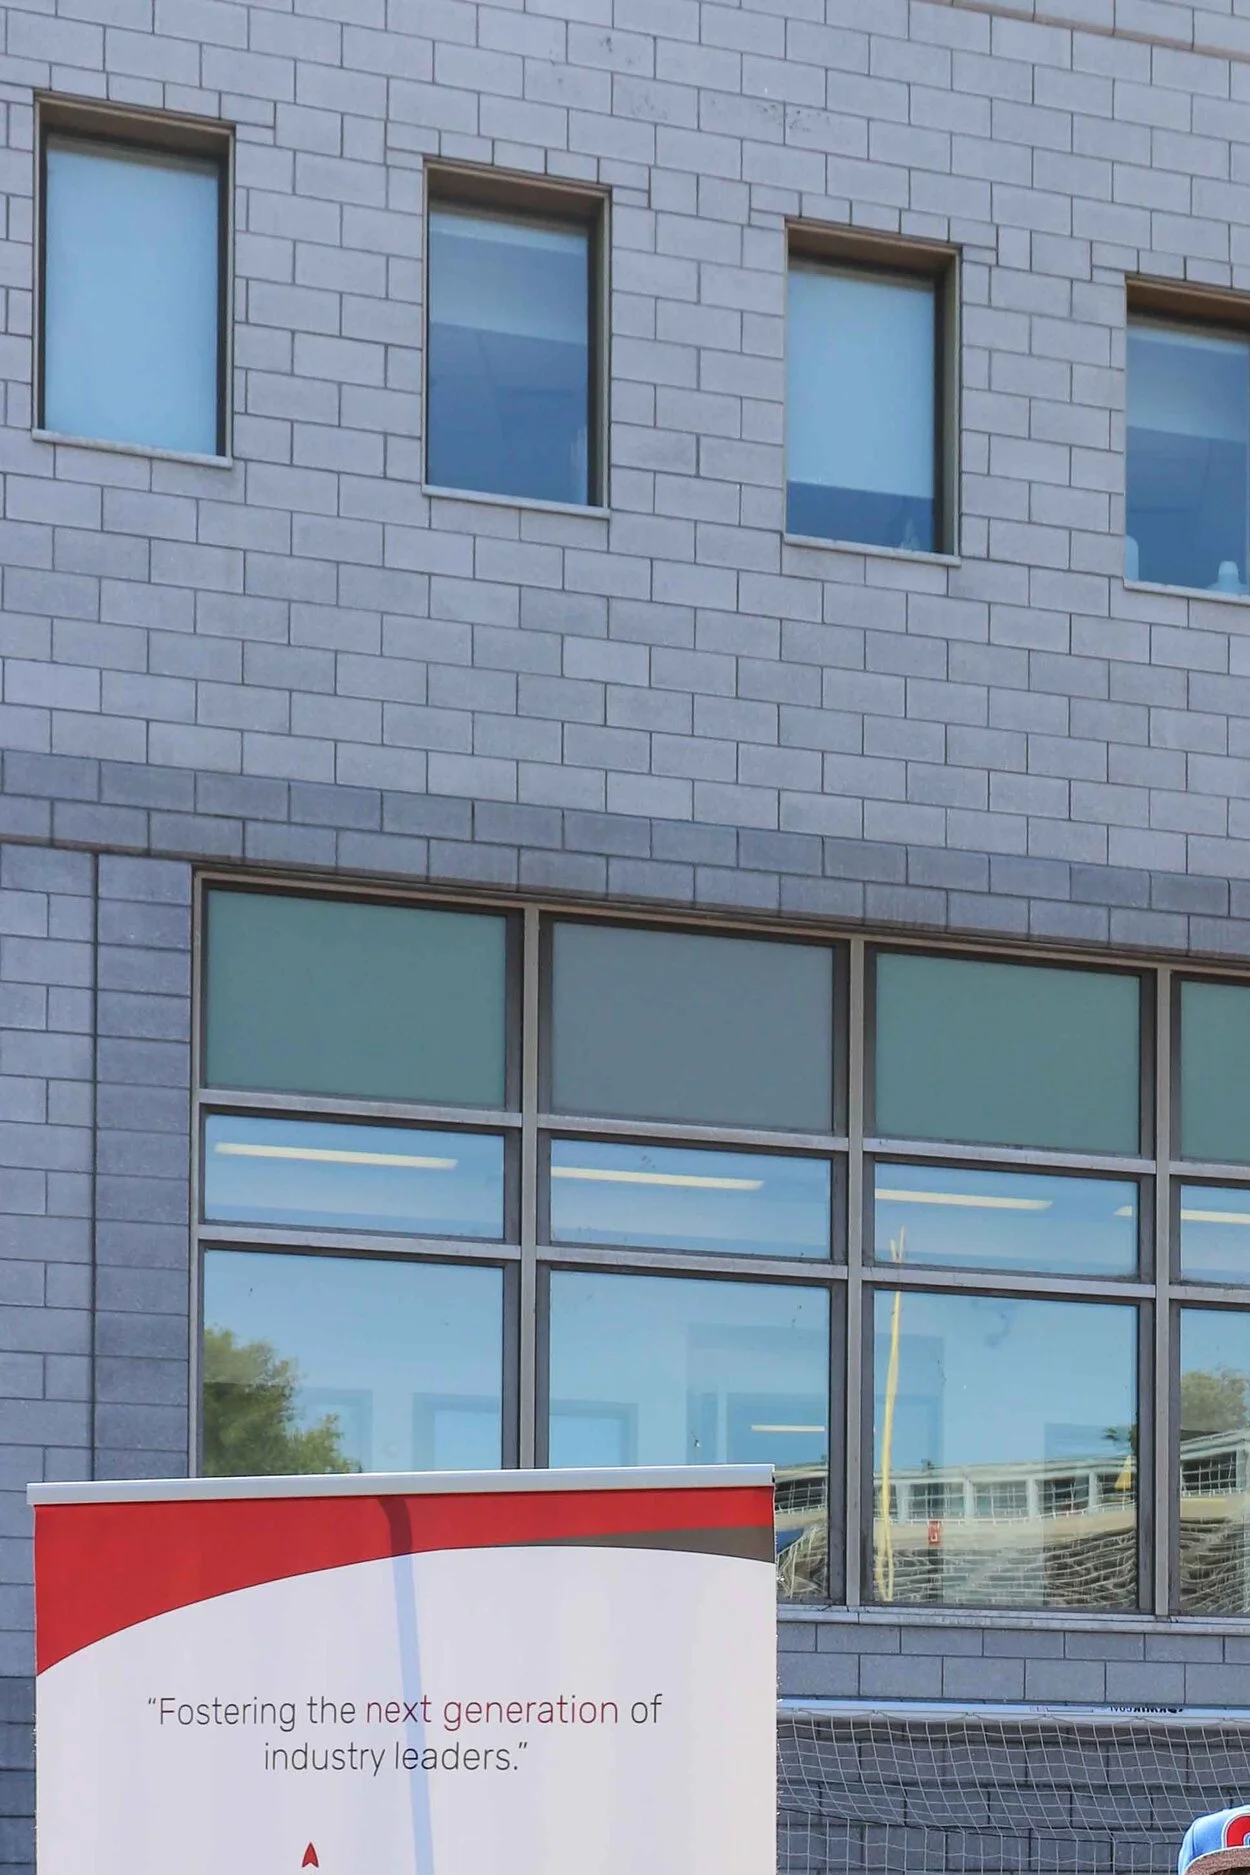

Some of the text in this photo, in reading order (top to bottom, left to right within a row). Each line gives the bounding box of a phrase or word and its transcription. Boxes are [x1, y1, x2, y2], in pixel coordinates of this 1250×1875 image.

[306, 1693, 356, 1726] the
[366, 1694, 432, 1726] next
[443, 1693, 619, 1732] generation
[630, 1692, 664, 1726] of
[263, 1740, 383, 1778] industry
